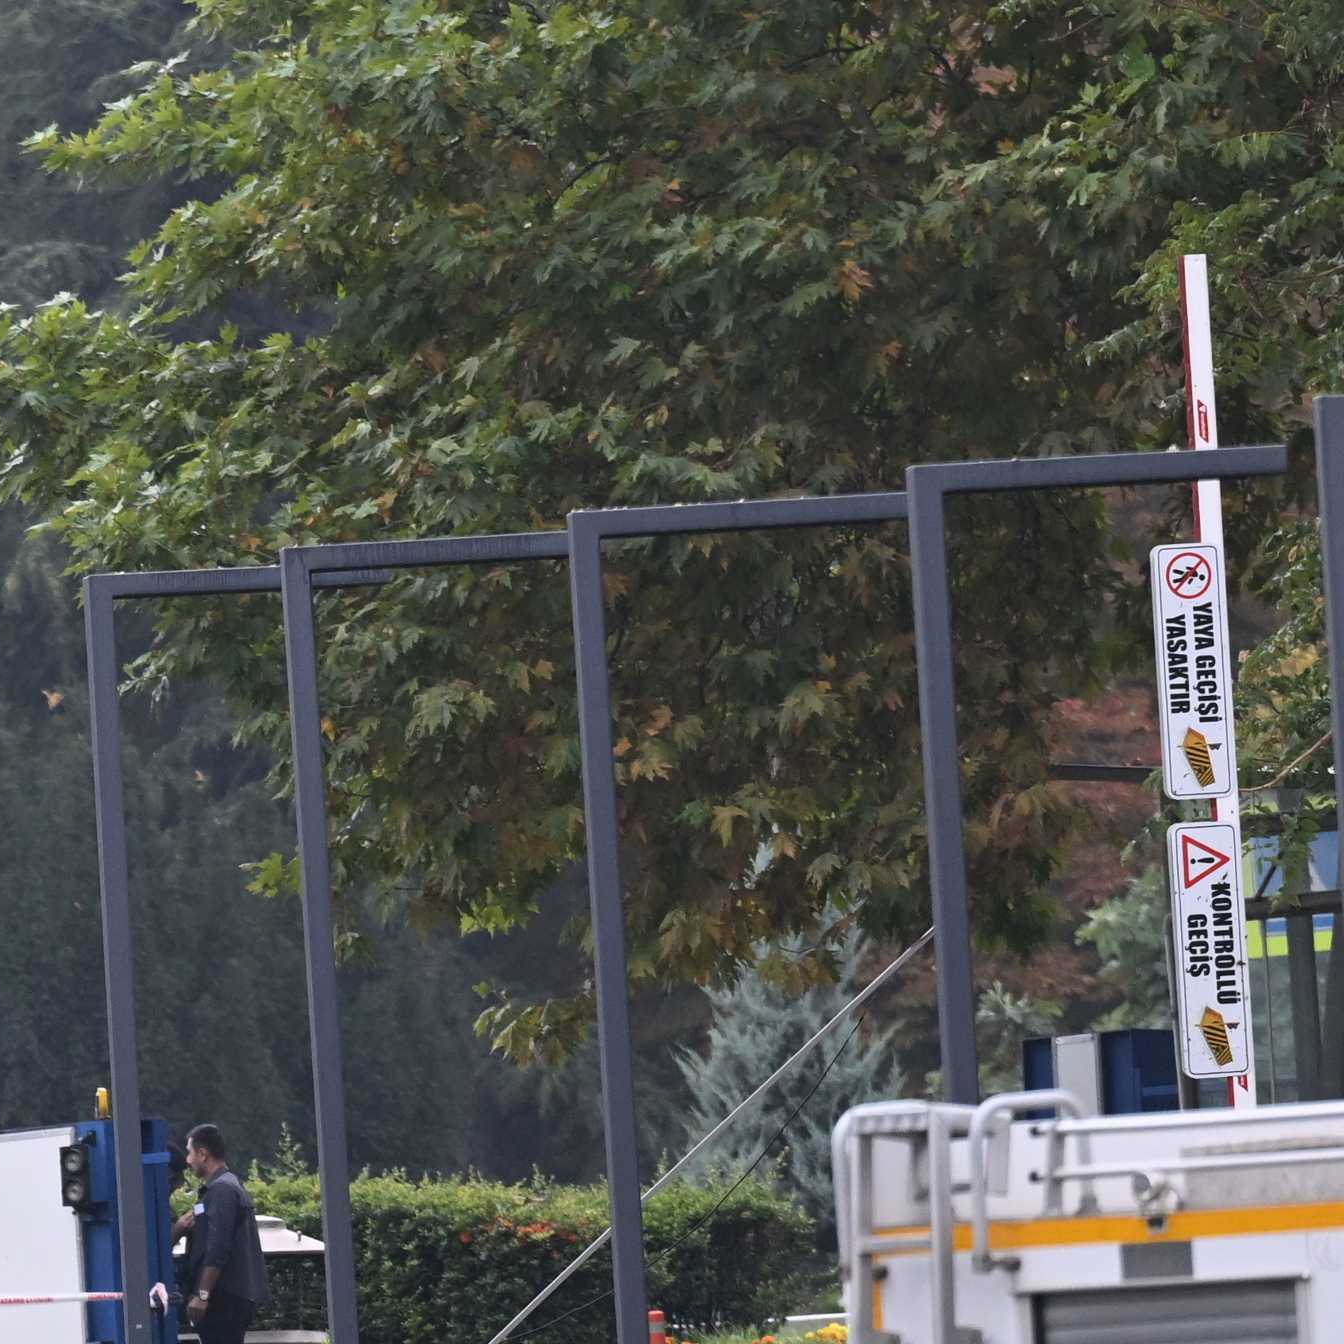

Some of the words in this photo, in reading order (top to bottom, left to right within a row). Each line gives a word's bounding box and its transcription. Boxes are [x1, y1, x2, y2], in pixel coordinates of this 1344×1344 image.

[1193, 602, 1214, 650] YAYA
[1166, 614, 1190, 714] YASAKTIR
[1193, 655, 1223, 723] GEÇİŞİ
[1185, 913, 1212, 977] GEÇİŞ
[1211, 883, 1241, 1005] KONTROLLÜ
